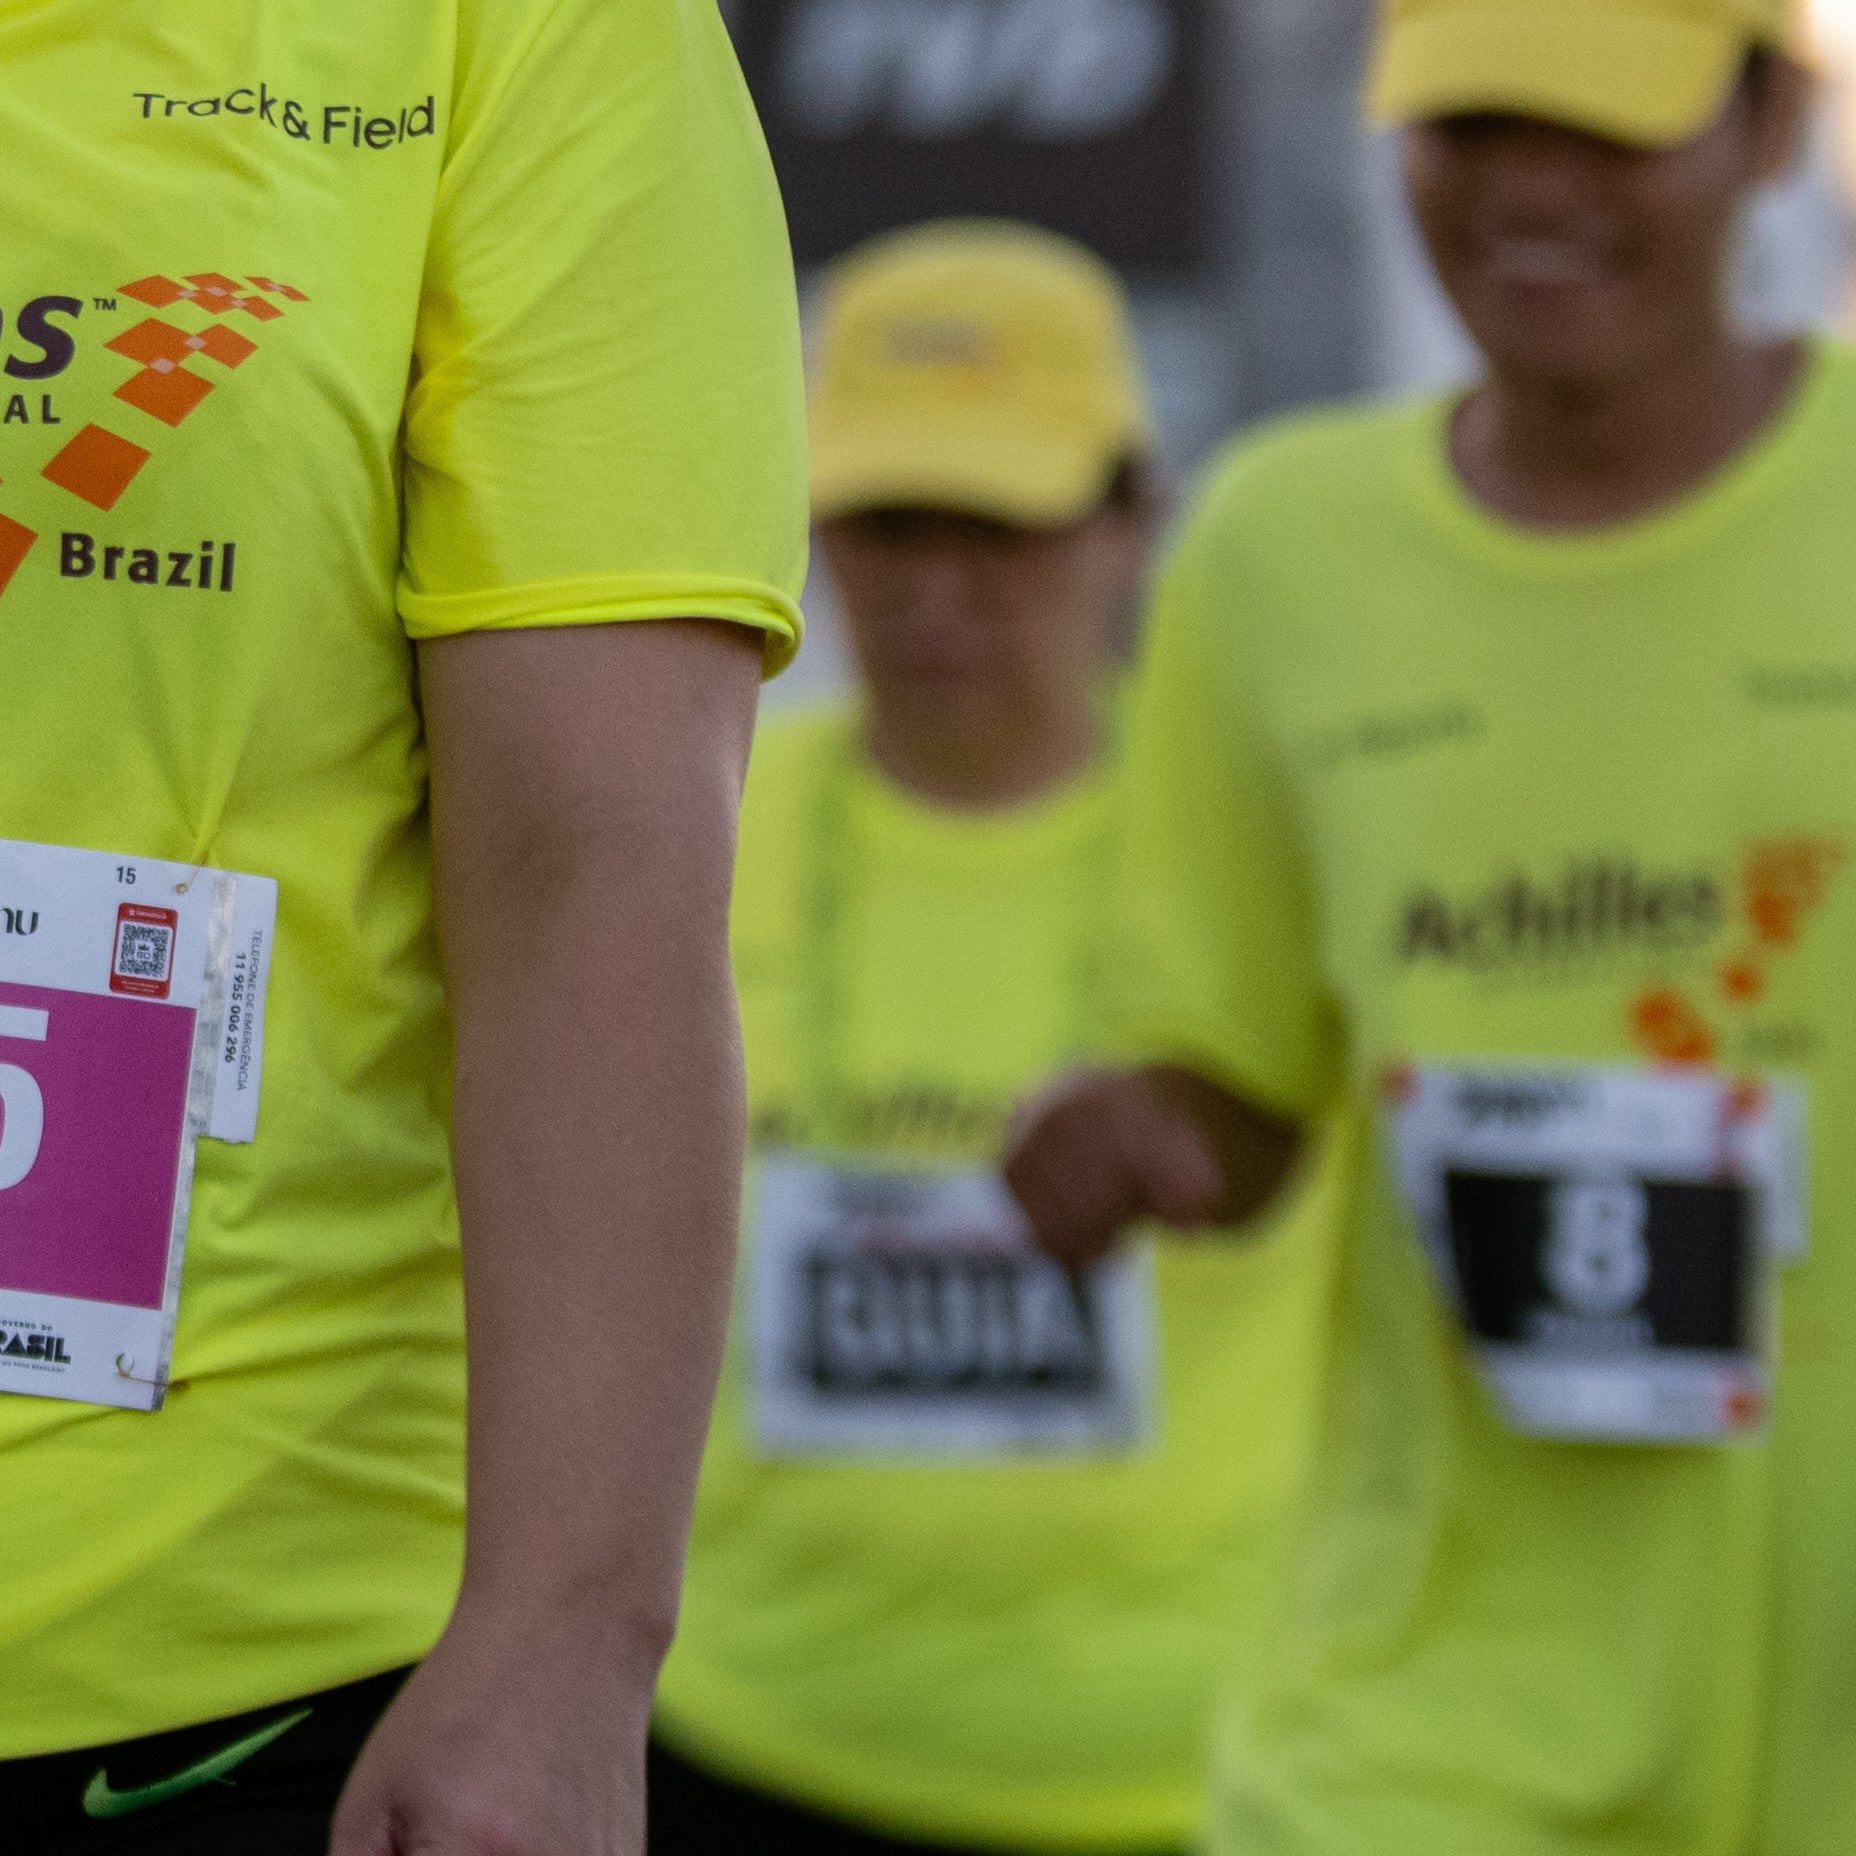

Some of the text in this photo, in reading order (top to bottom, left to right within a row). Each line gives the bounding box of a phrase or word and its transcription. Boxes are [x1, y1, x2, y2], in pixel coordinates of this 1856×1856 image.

[59, 533, 236, 593] Brazil
[116, 866, 136, 885] 15
[246, 930, 262, 991] TELEFONE
[225, 952, 246, 1063] 11 955 006 296
[245, 993, 255, 1009] DE
[1546, 1179, 1651, 1312] 8
